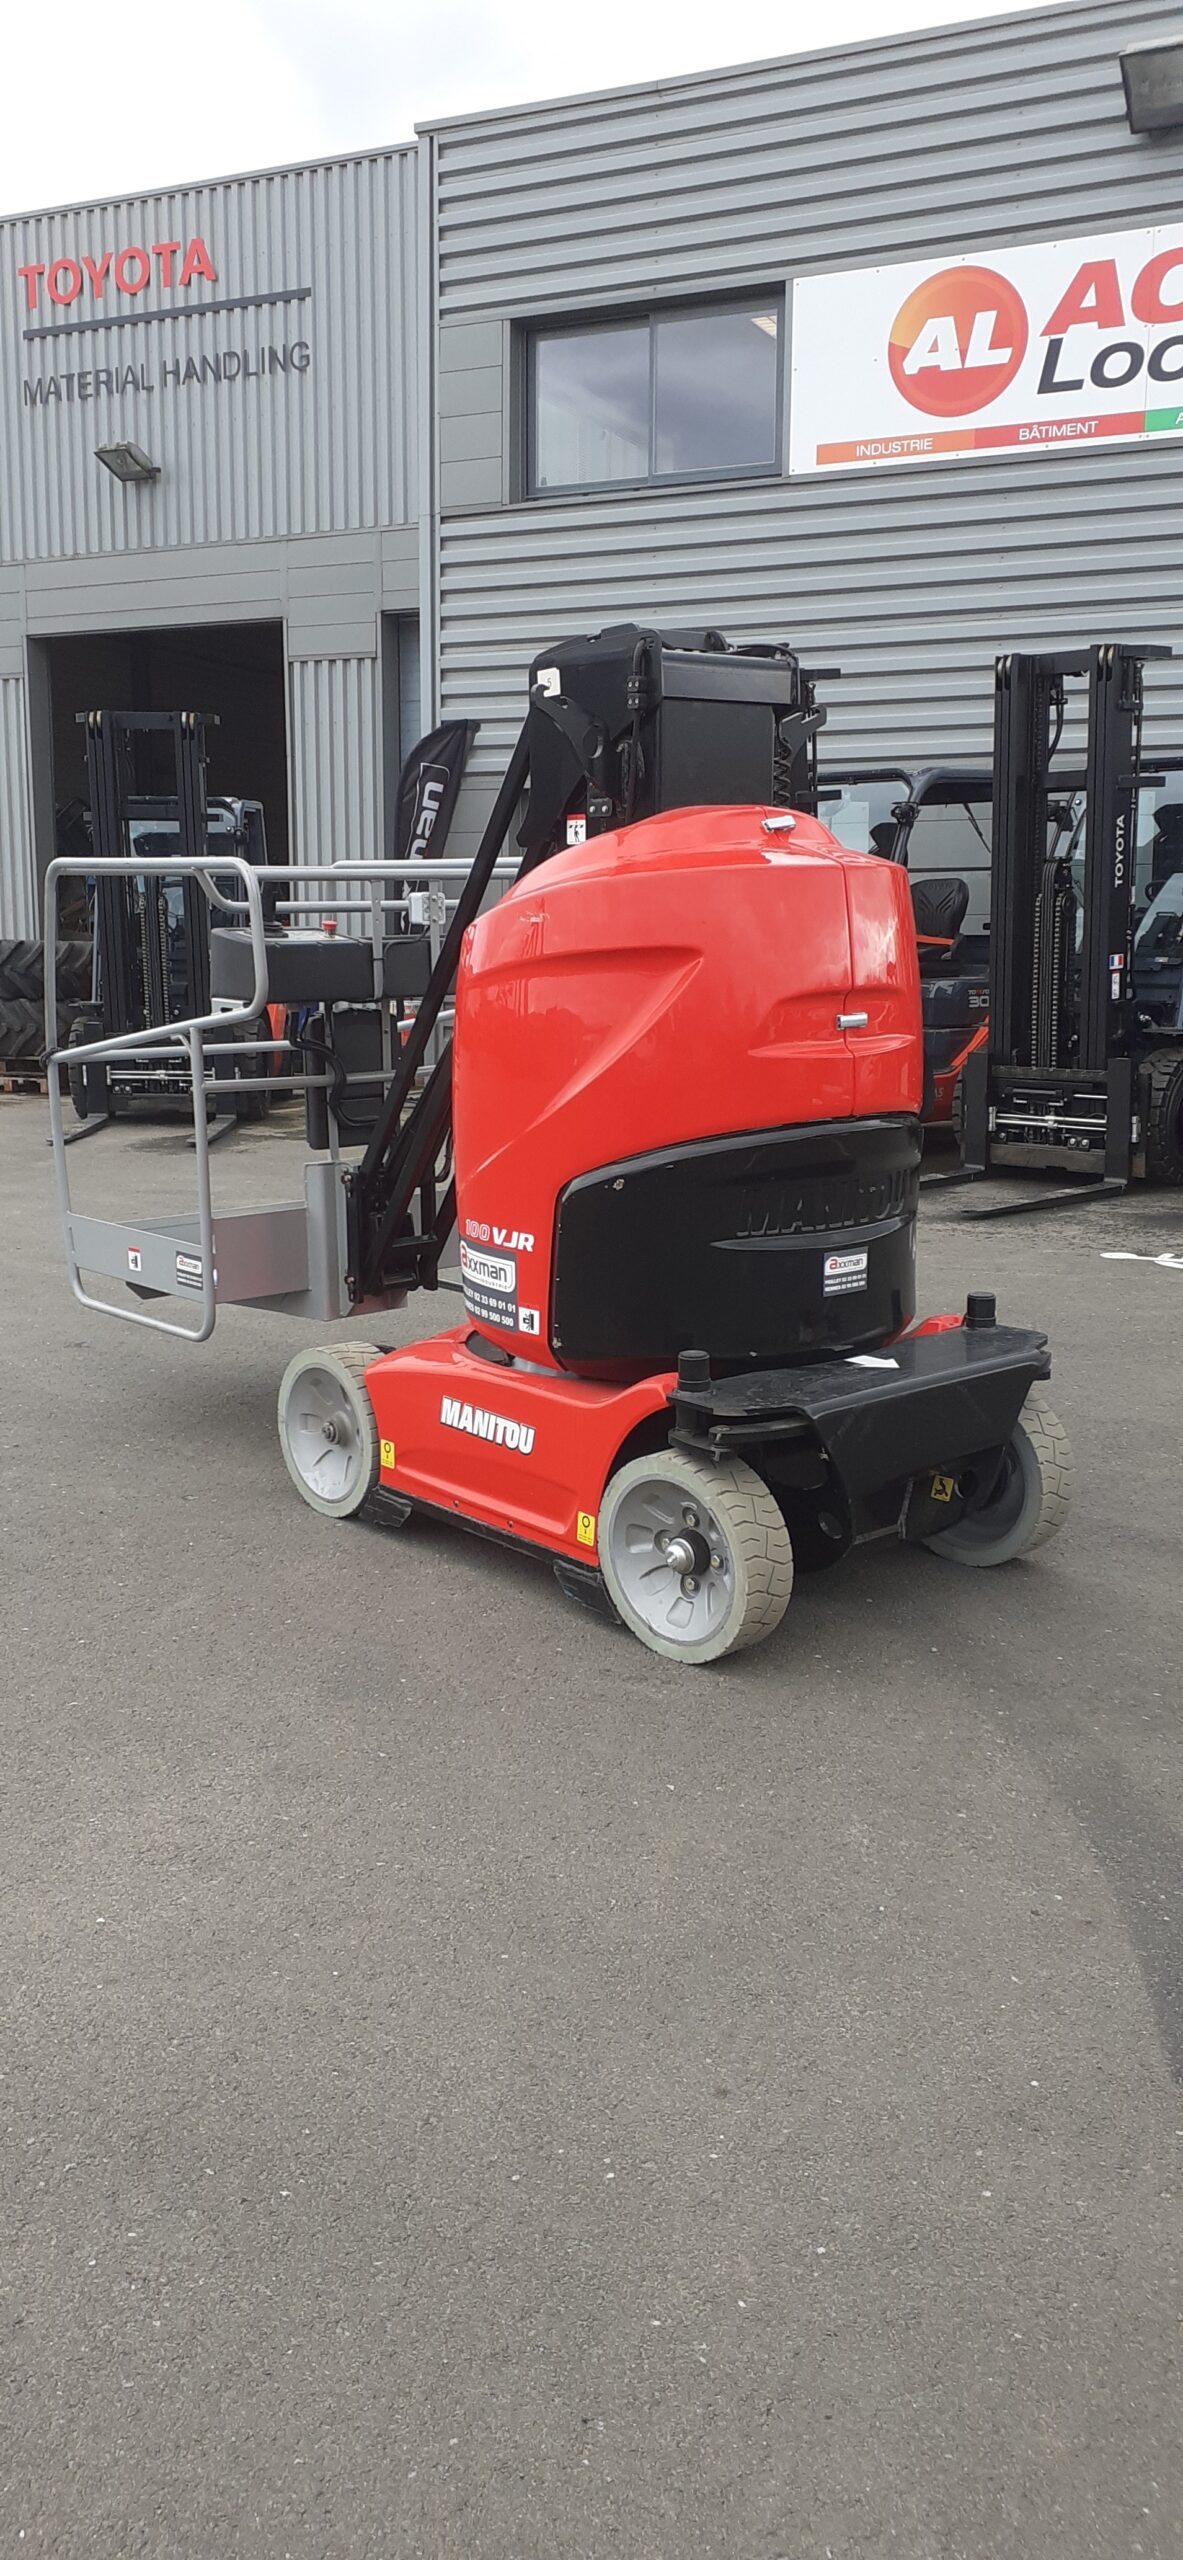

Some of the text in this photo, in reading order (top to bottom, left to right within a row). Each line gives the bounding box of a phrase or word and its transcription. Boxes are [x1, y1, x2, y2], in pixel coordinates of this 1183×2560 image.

[17, 236, 217, 311] TOYOTA
[902, 310, 1013, 375] AL
[23, 341, 311, 406] MATERIAL HANDLING
[856, 438, 933, 457] INDUSTRIE
[1019, 421, 1098, 441] BÂTIMENT
[1114, 814, 1125, 888] TOYOTA
[968, 995, 989, 1008] 30
[465, 1219, 535, 1252] 100 VJR
[497, 1300, 506, 1311] 01
[507, 1303, 516, 1313] 01
[501, 1315, 514, 1327] 500
[440, 1395, 536, 1456] MANITOU
